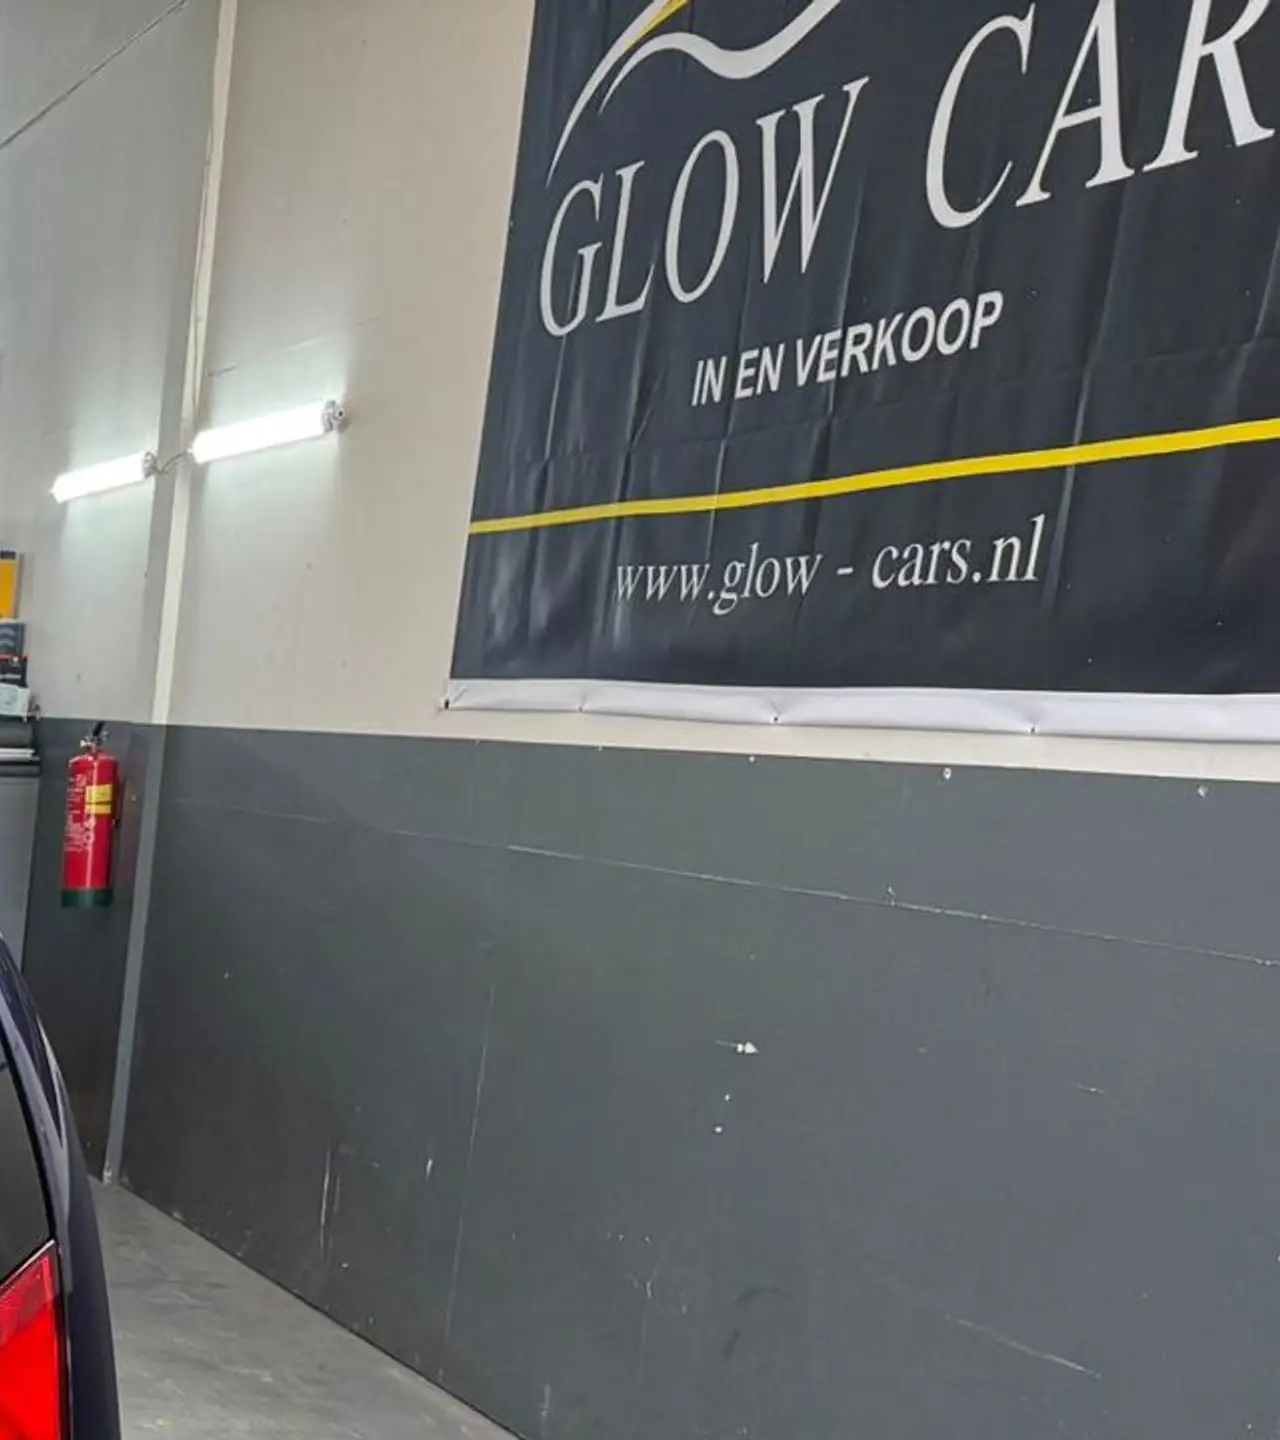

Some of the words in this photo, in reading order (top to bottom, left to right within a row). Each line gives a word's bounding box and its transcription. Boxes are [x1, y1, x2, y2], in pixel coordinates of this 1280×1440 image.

[540, 76, 869, 336] GLOW
[692, 356, 727, 406] IN
[734, 344, 786, 399] EN
[797, 290, 1004, 387] VERKOOP
[615, 543, 823, 616] www.glow
[872, 514, 1045, 589] cars.nl
